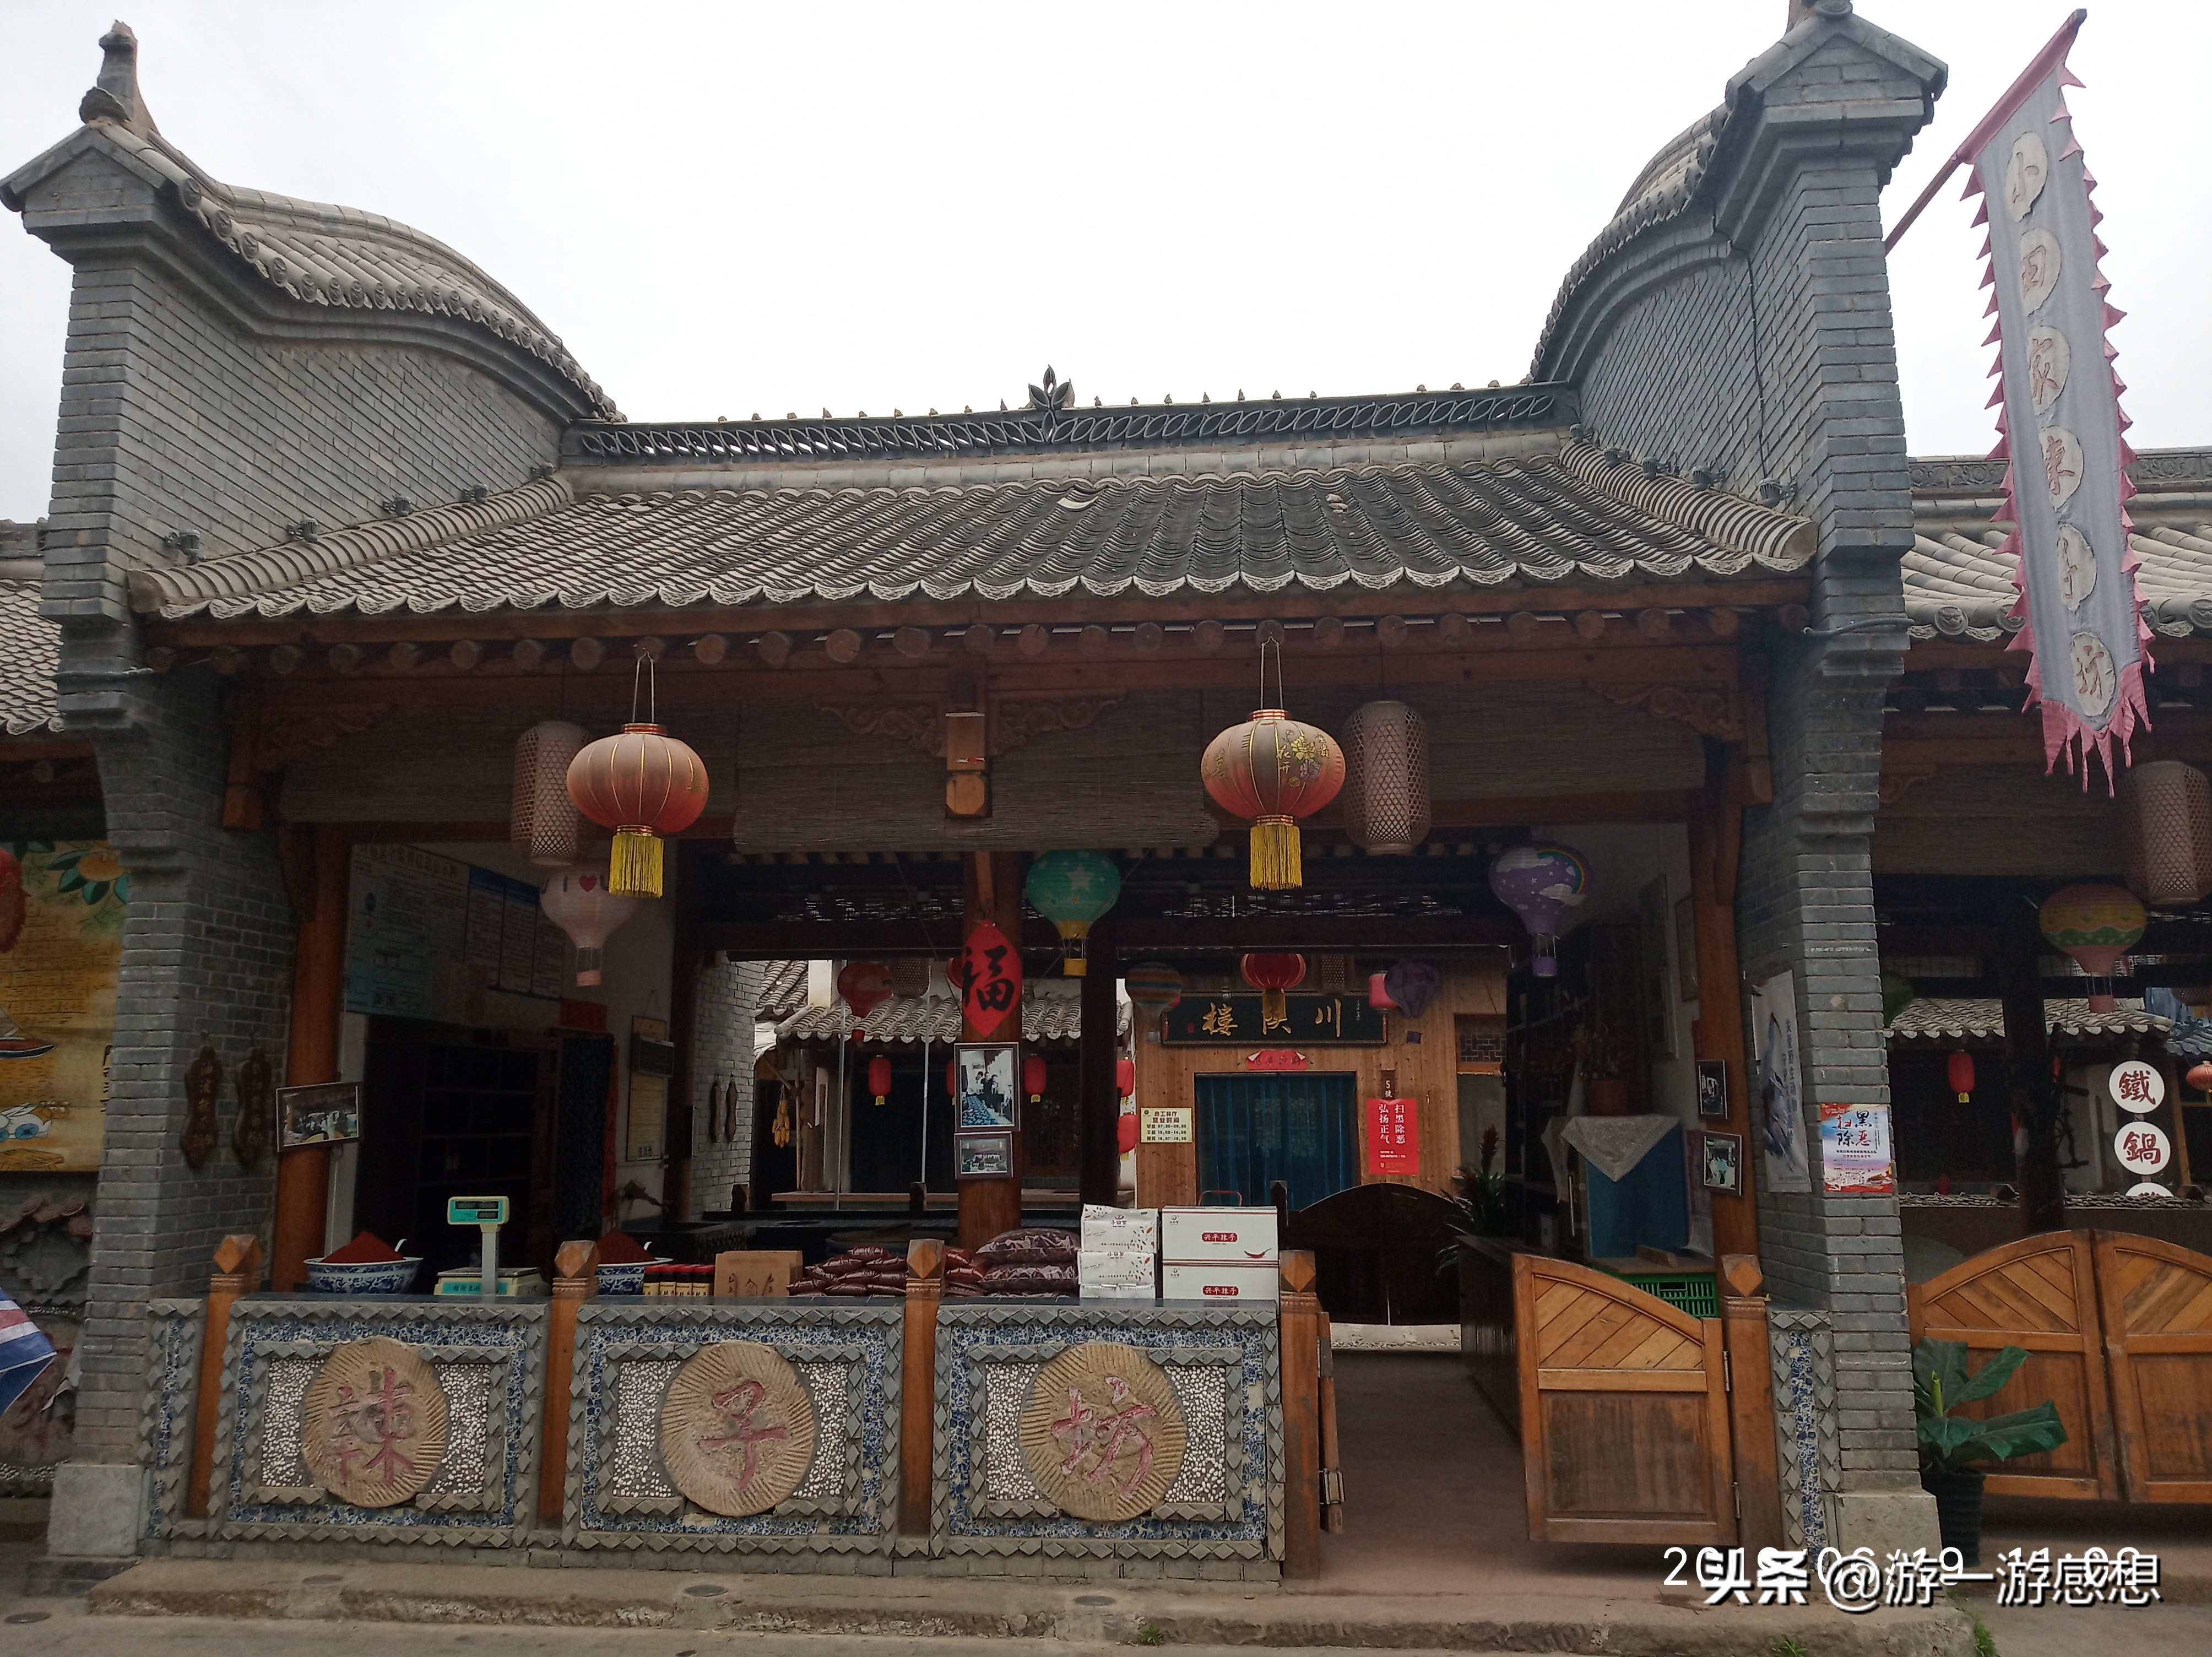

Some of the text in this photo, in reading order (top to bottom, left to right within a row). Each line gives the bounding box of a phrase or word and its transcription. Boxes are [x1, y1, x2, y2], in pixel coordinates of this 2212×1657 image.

[961, 945, 1015, 1012] 福
[1378, 1103, 1390, 1144] 弘扬正气
[1394, 1103, 1406, 1144] 扫黑除恶
[1836, 1110, 1873, 1129] 扫黑
[1836, 1130, 1872, 1147] 除恶
[2118, 1070, 2161, 1198] 鐵鍋
[1203, 1233, 1236, 1242] 兴平辣子
[327, 1366, 1157, 1501] 辣 子 坊
